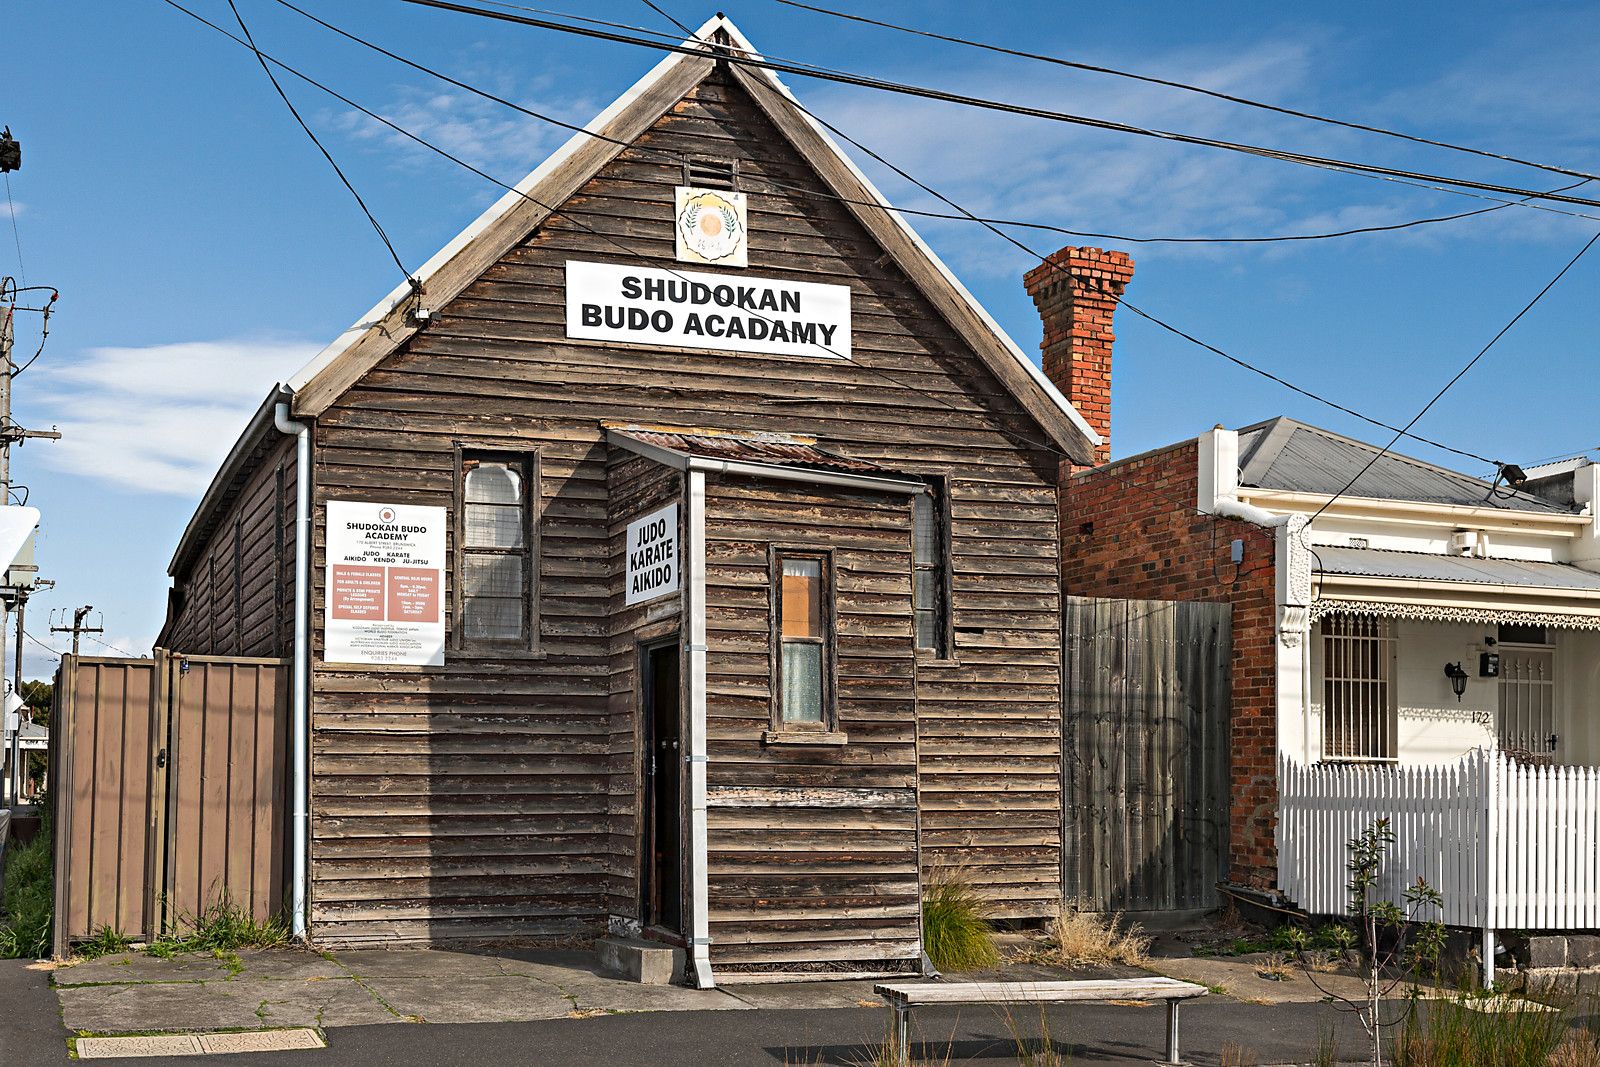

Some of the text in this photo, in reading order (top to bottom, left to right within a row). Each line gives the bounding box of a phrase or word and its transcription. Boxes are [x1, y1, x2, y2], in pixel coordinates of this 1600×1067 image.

[621, 276, 801, 313] SHUDOKAN
[581, 303, 838, 346] BUDO ACADAMY
[346, 522, 427, 534] SHUDOKAN BUDO
[365, 532, 409, 541] ACADEMY
[637, 518, 666, 547] JUDO
[630, 538, 673, 572] KARATE
[632, 563, 671, 594] AIKIDO
[1472, 711, 1490, 724] 172
